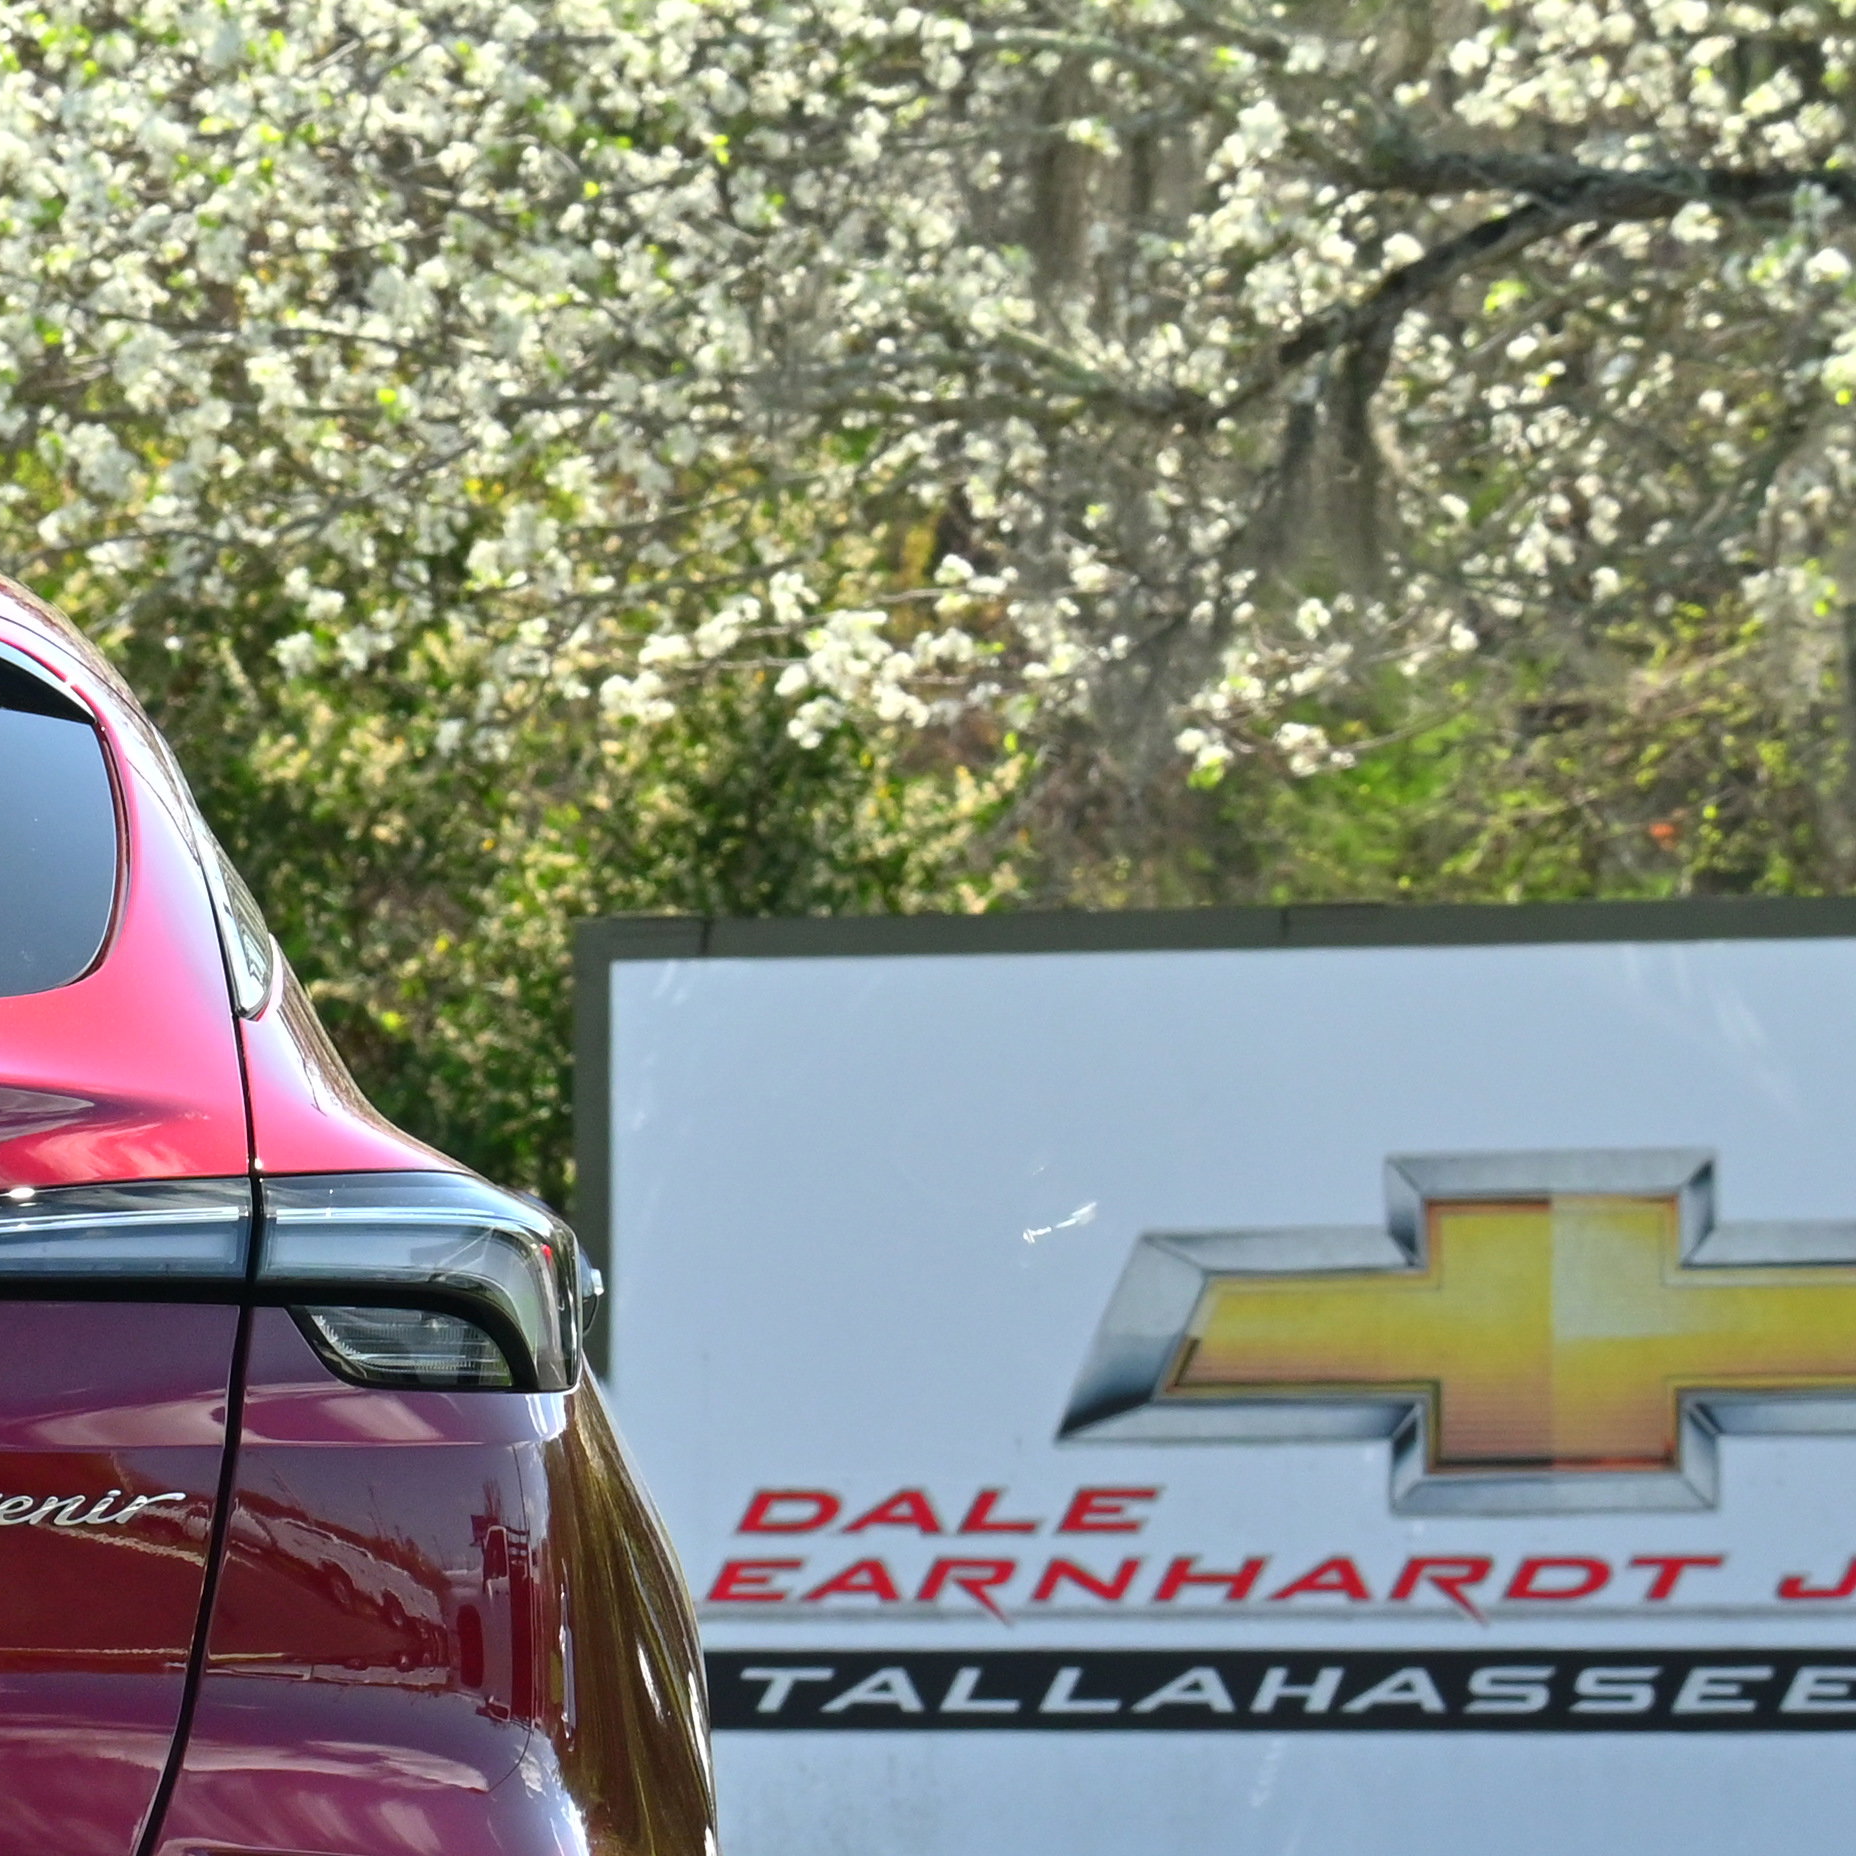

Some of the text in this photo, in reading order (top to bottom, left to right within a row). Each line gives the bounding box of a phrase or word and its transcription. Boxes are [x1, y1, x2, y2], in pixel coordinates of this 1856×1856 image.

[735, 1488, 1163, 1535] DALE
[704, 1555, 1726, 1626] EARNHARDT
[740, 1666, 1856, 1714] TALLAHASSEE
